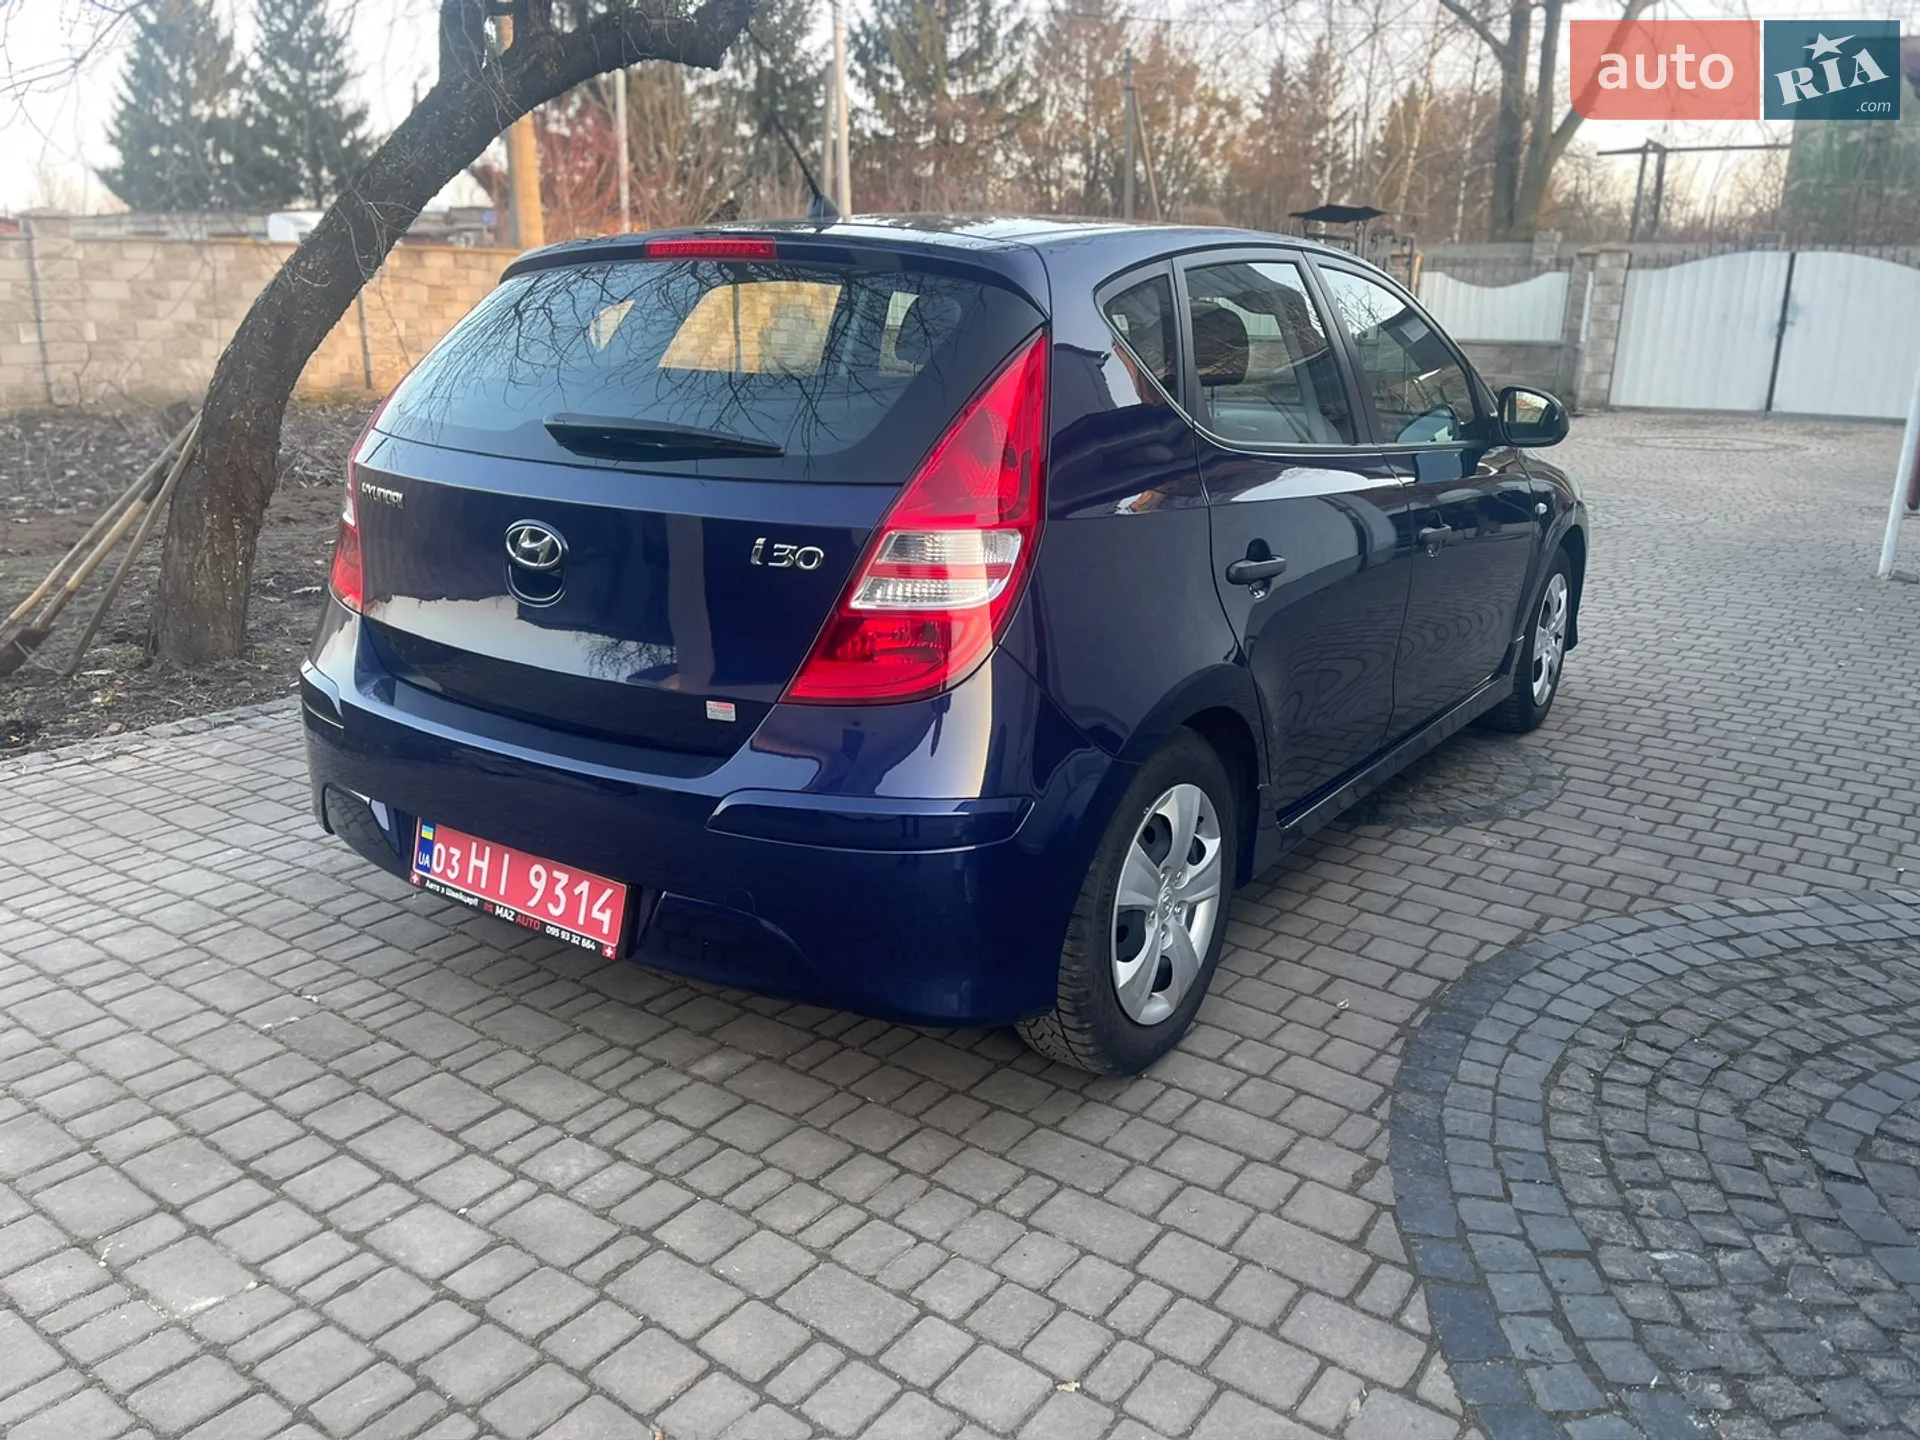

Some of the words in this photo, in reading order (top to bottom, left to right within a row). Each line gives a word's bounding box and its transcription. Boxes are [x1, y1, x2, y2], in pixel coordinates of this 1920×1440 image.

[361, 481, 404, 509] HYUNDAI
[418, 851, 431, 868] UA
[431, 842, 461, 880] 03
[527, 863, 615, 935] 9314
[494, 905, 516, 922] MAZ
[515, 914, 540, 931] AUTO
[570, 933, 581, 946] 32
